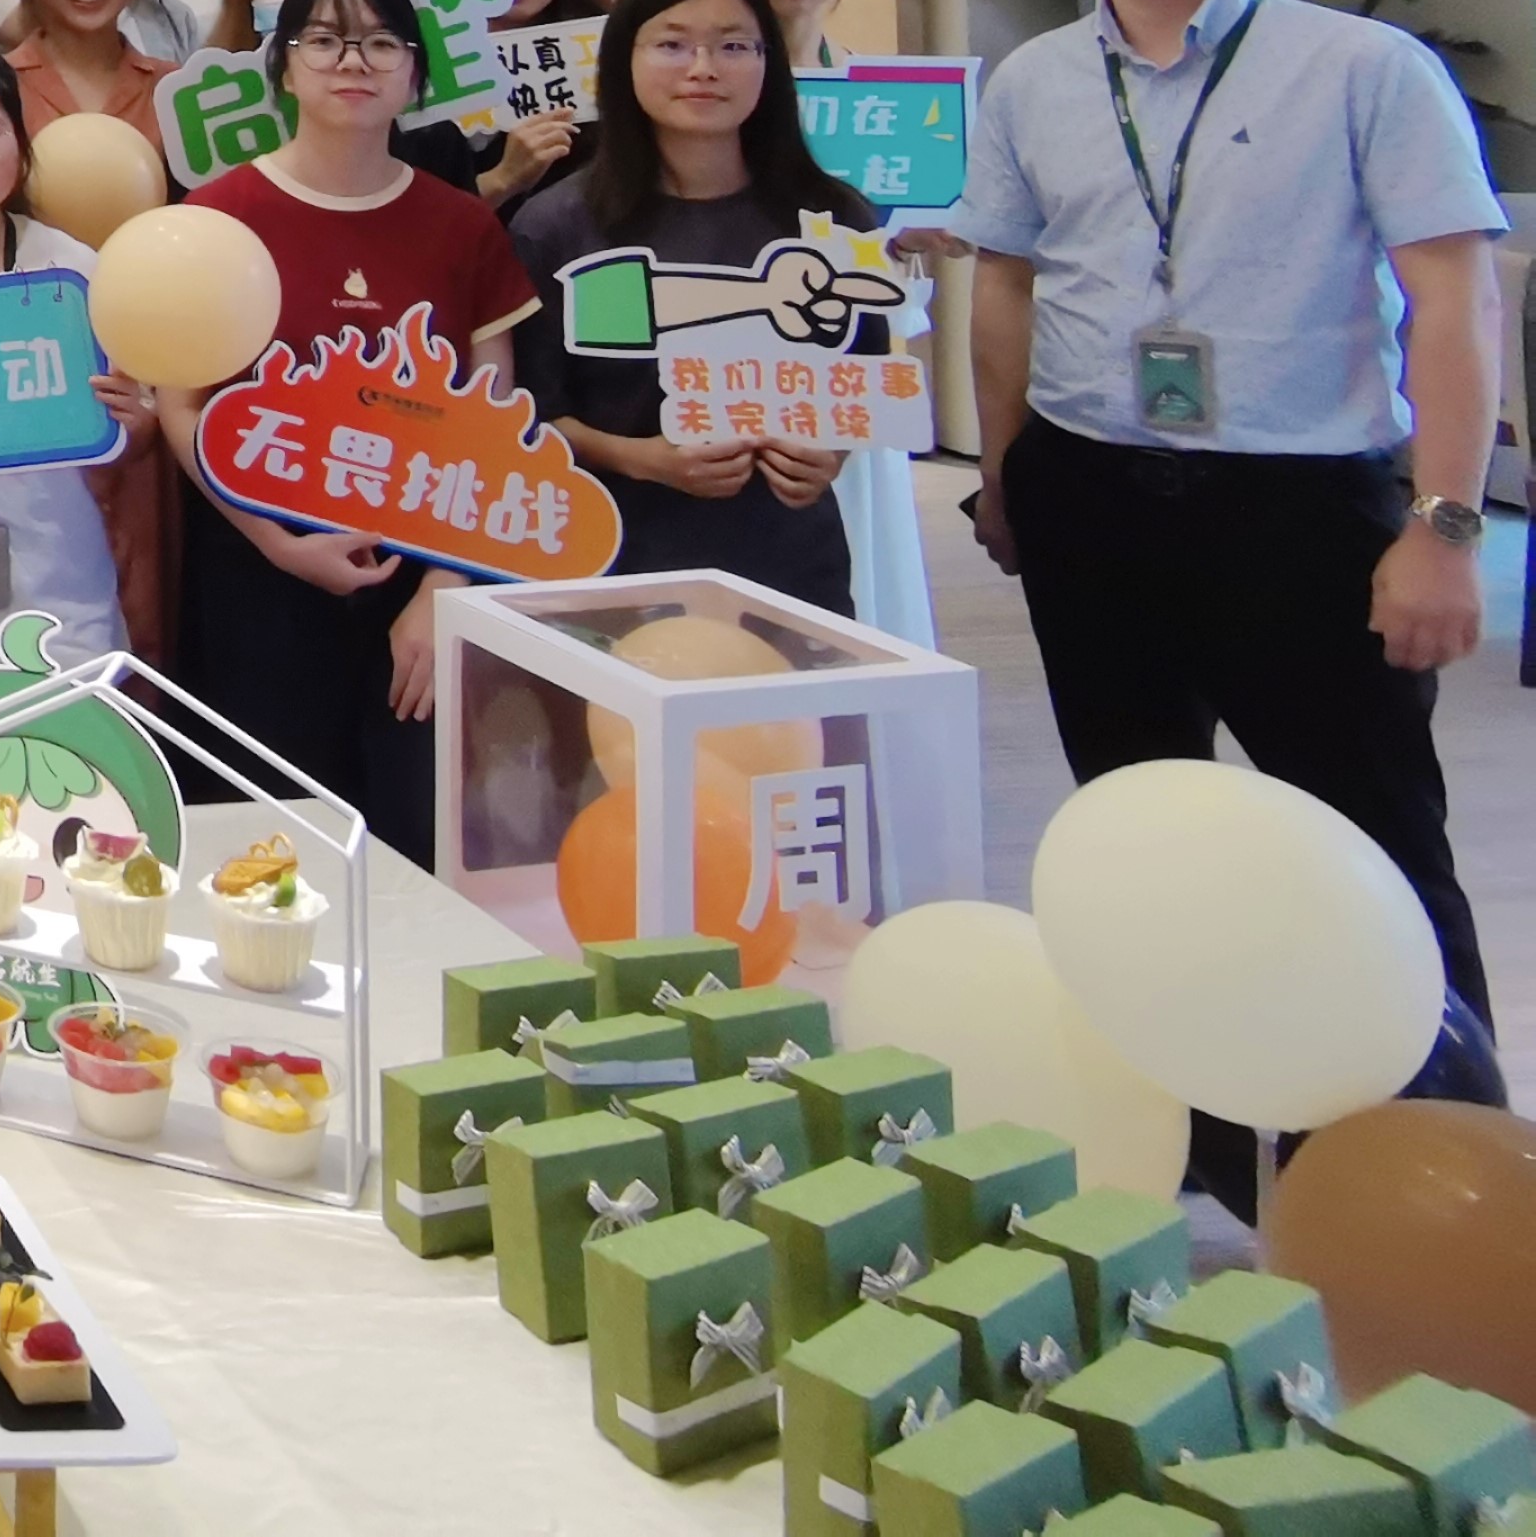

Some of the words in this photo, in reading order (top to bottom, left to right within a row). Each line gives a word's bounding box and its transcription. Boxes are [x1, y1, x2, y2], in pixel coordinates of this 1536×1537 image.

[670, 356, 922, 400] 我们的故事
[676, 399, 872, 440] 未完待续
[233, 405, 572, 556] 无畏挑战
